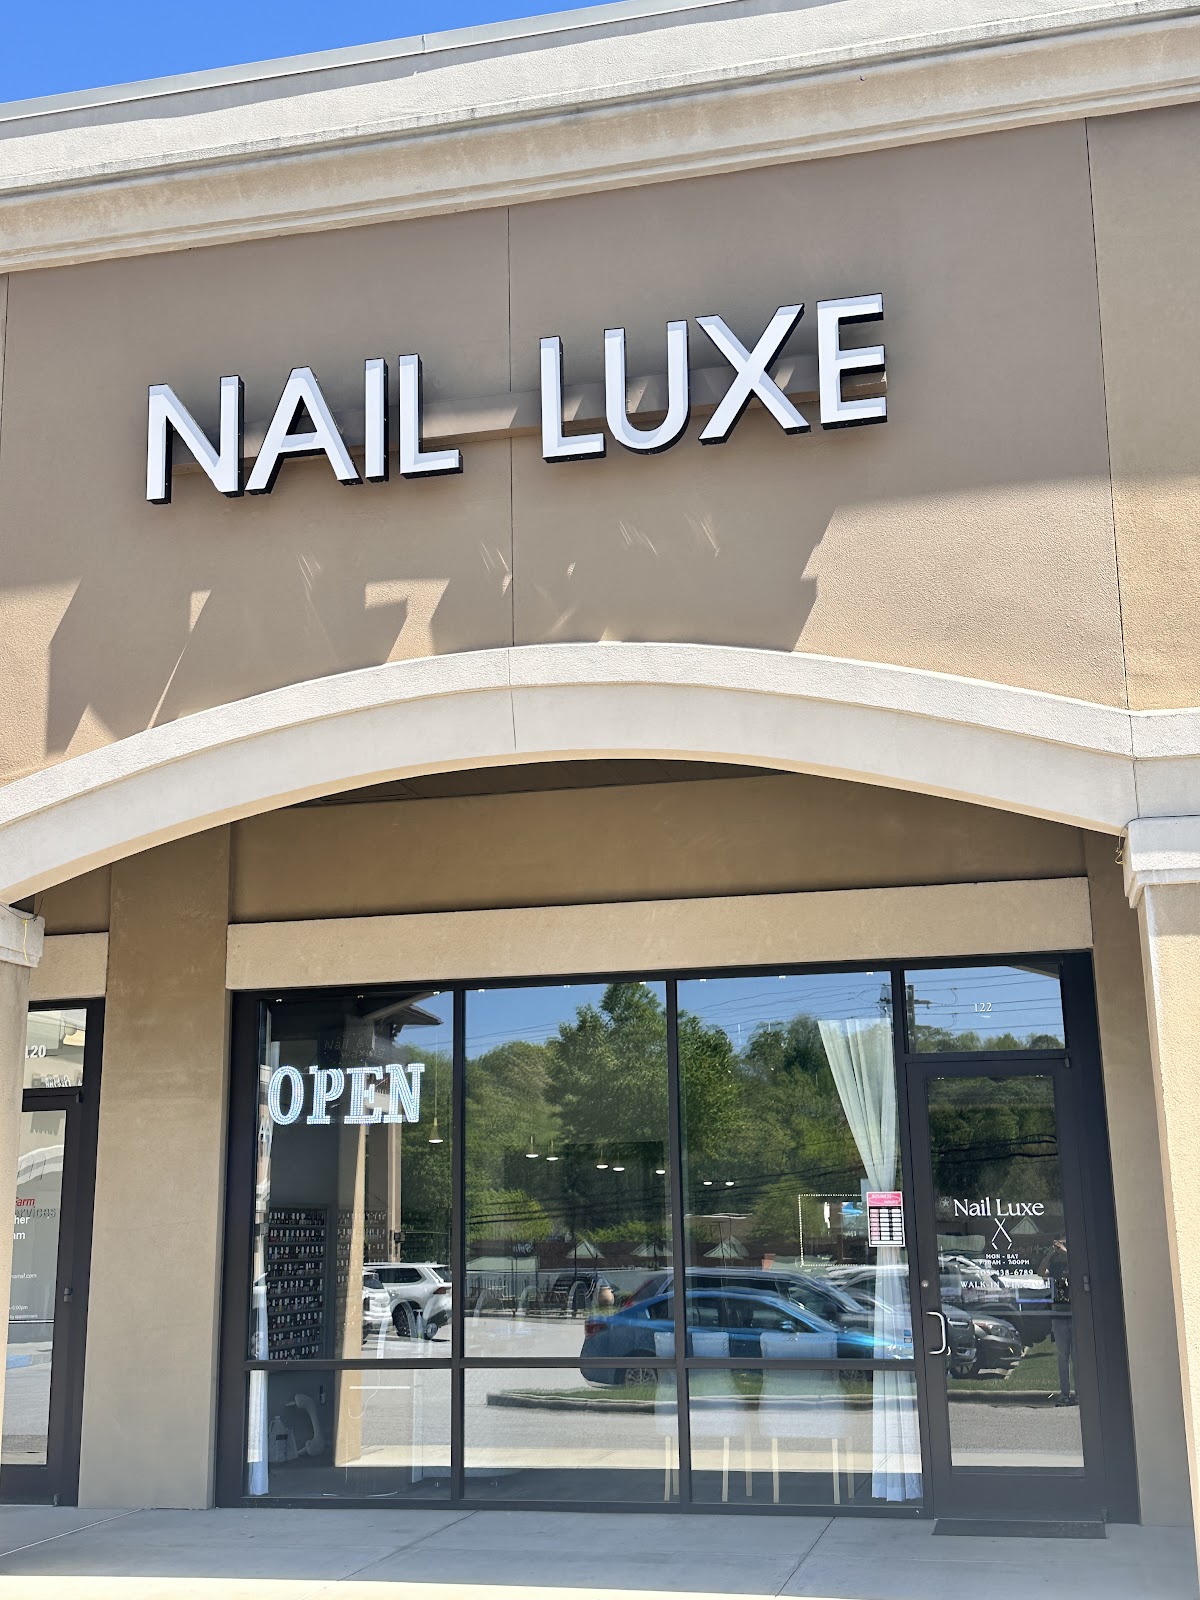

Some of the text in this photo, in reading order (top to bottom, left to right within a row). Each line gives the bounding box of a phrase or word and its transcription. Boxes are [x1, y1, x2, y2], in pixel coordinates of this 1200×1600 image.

[145, 293, 889, 504] NAIL LUXE
[974, 1002, 993, 1012] 122
[268, 1063, 425, 1125] OPEN
[953, 1197, 1045, 1217] Nail Luxe
[960, 1281, 986, 1289] WALK
